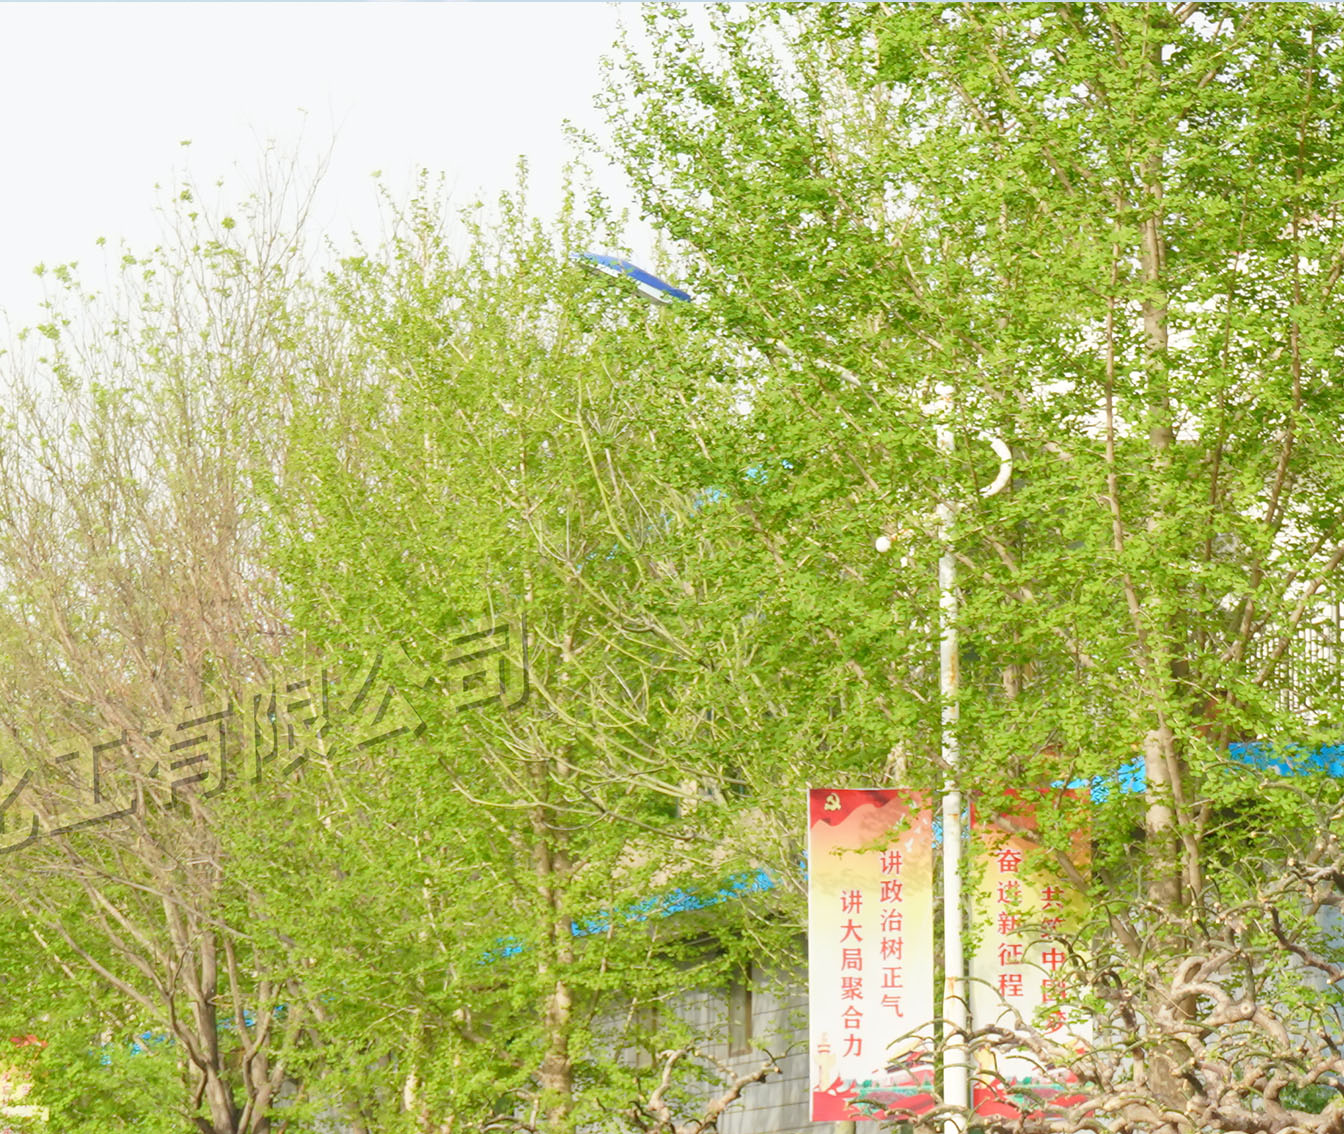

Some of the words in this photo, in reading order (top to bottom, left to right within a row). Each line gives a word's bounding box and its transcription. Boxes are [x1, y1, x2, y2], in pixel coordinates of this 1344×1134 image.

[840, 889, 864, 1058] 讲大局聚合力
[879, 850, 904, 1019] 讲政治树正气
